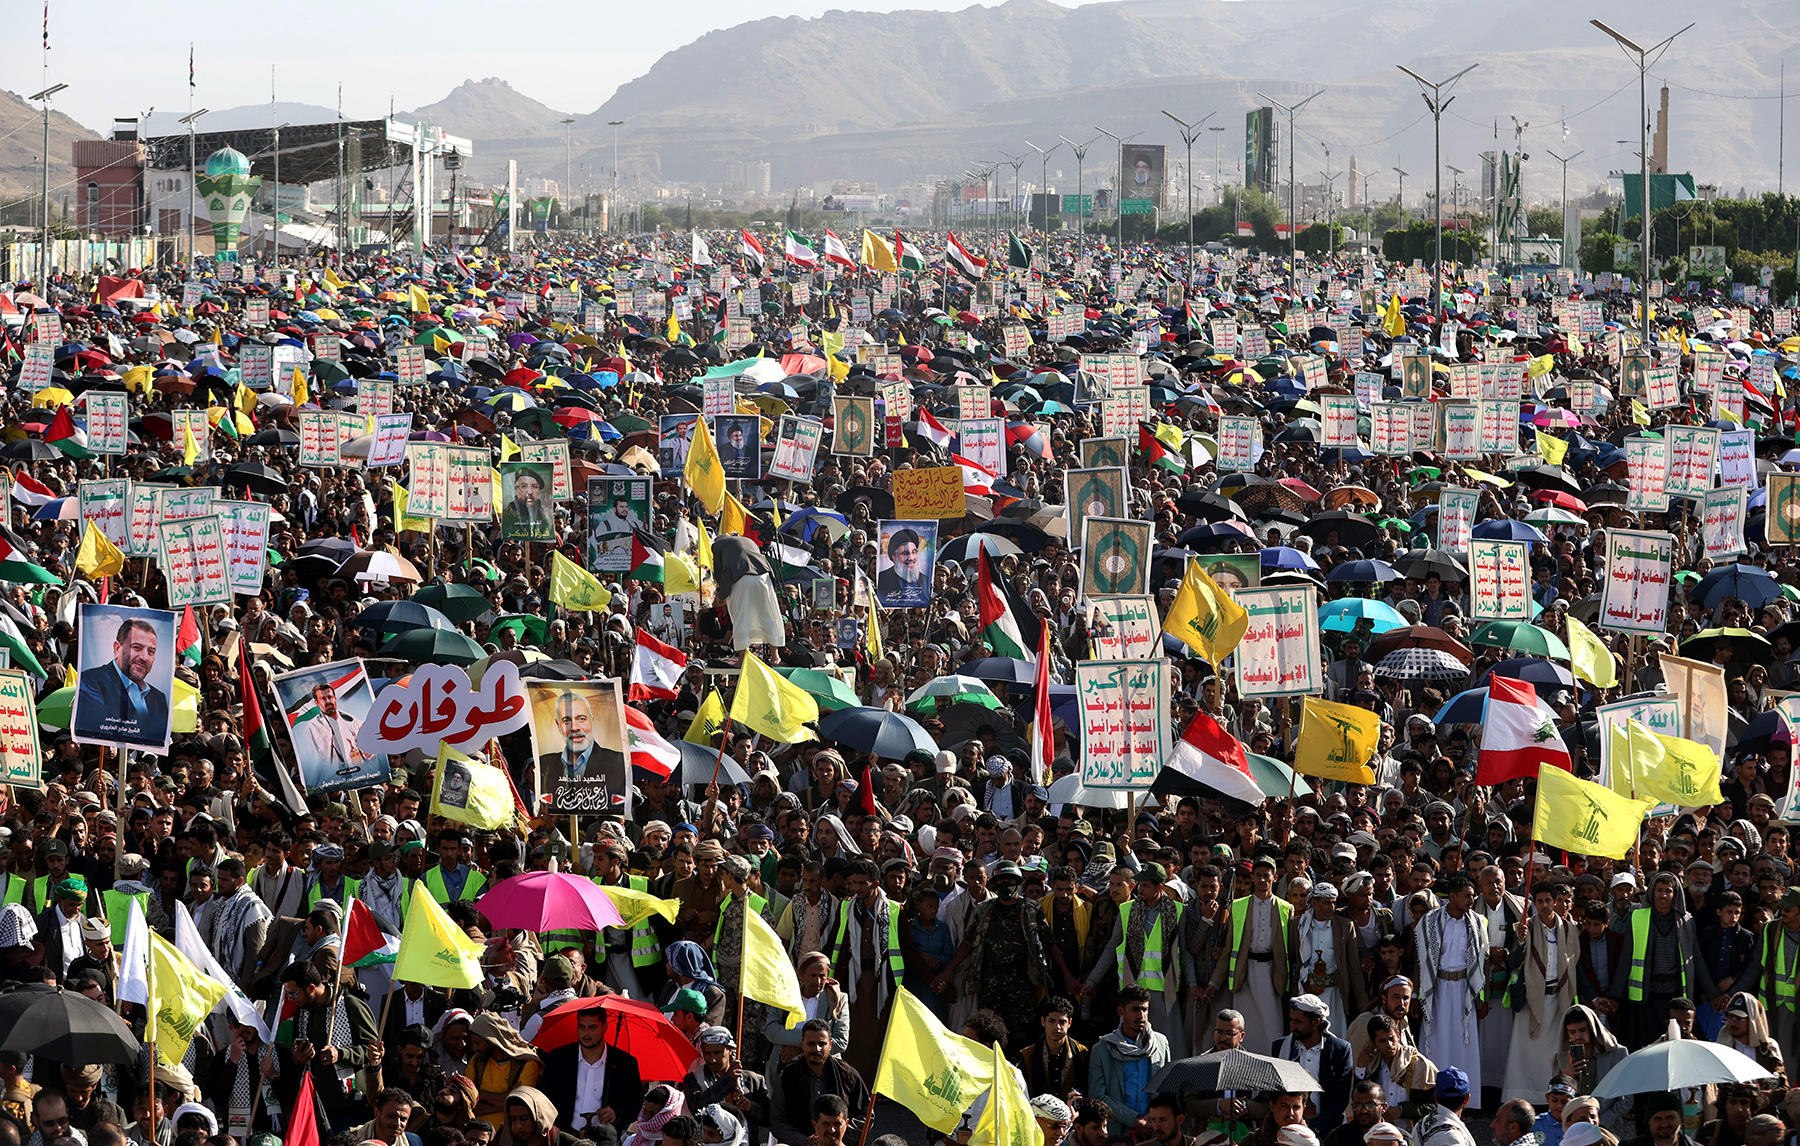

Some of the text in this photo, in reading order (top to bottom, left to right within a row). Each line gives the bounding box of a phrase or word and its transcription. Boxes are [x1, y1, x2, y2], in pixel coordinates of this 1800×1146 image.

[963, 425, 997, 437] قاطعوا
[1674, 431, 1713, 445] الله أكبر
[964, 439, 998, 449] البضائع الأمريكية
[1722, 435, 1748, 449] قاطعوا
[416, 448, 437, 461] أكبر
[526, 445, 563, 460] الله أكبر
[1628, 444, 1652, 458] أكبر
[1673, 446, 1712, 457] الموت لأمريكا
[1723, 451, 1749, 462] البضائع الأمريكية
[449, 453, 490, 468] قاطعوا
[1673, 459, 1710, 469] الموت لإسرائيل
[1736, 463, 1738, 471] و
[449, 471, 491, 485] البضائع الأمريكية
[1670, 470, 1709, 480] اللعنة على اليهود
[1724, 474, 1751, 484] الإسرائيلية
[467, 488, 471, 497] و
[1666, 481, 1708, 494] النصر للإسلام
[83, 487, 123, 505] قاطعوا
[165, 492, 193, 510] أكبر
[107, 507, 123, 520] البضائع
[246, 508, 265, 521] الله
[450, 501, 491, 514] الإسرائيلية
[166, 521, 216, 543] الله أكبر
[241, 528, 264, 537] الموت
[508, 528, 550, 538] فؤاد شكر
[168, 540, 220, 554] الموت لأمريكا
[240, 542, 262, 551] الموت
[1476, 544, 1522, 559] الله أكبر
[1614, 542, 1669, 562] قاطعوا
[171, 554, 222, 570] الموت لإسرائيل
[231, 555, 261, 565] اللعنة على
[1476, 560, 1523, 572] الموت لأمريكا
[173, 569, 224, 585] اللعنة على اليهود
[236, 568, 259, 581] النصر
[1478, 575, 1524, 586] الموت لإسرائيل
[1612, 565, 1668, 584] البضائع الأمريكية
[174, 582, 226, 602] النصر للإسلام
[1478, 588, 1525, 599] اللعنة على اليهود
[1634, 588, 1639, 600] و
[1478, 600, 1525, 615] النصر للإسلام
[1608, 603, 1664, 624] الإسرائيلية
[1275, 623, 1304, 642] البضائع
[1270, 646, 1275, 660] و
[1084, 666, 1155, 695] الله أكبر
[1243, 664, 1307, 685] الإسرائيلية
[1, 681, 24, 698] الله
[377, 674, 525, 744] طوفان
[1085, 694, 1155, 713] الموت لأمريكا
[1648, 709, 1674, 728] الله
[2, 724, 31, 736] الموت
[1088, 718, 1155, 735] الموت لإسرائيل
[12, 741, 33, 755] اللعنة
[1088, 740, 1157, 757] اللعنة على اليهود
[6, 759, 35, 779] النصر
[1087, 759, 1158, 784] النصر للإسلام
[558, 774, 605, 783] الشهيد المجاهد
[556, 785, 608, 810] إسماعيل هنية
